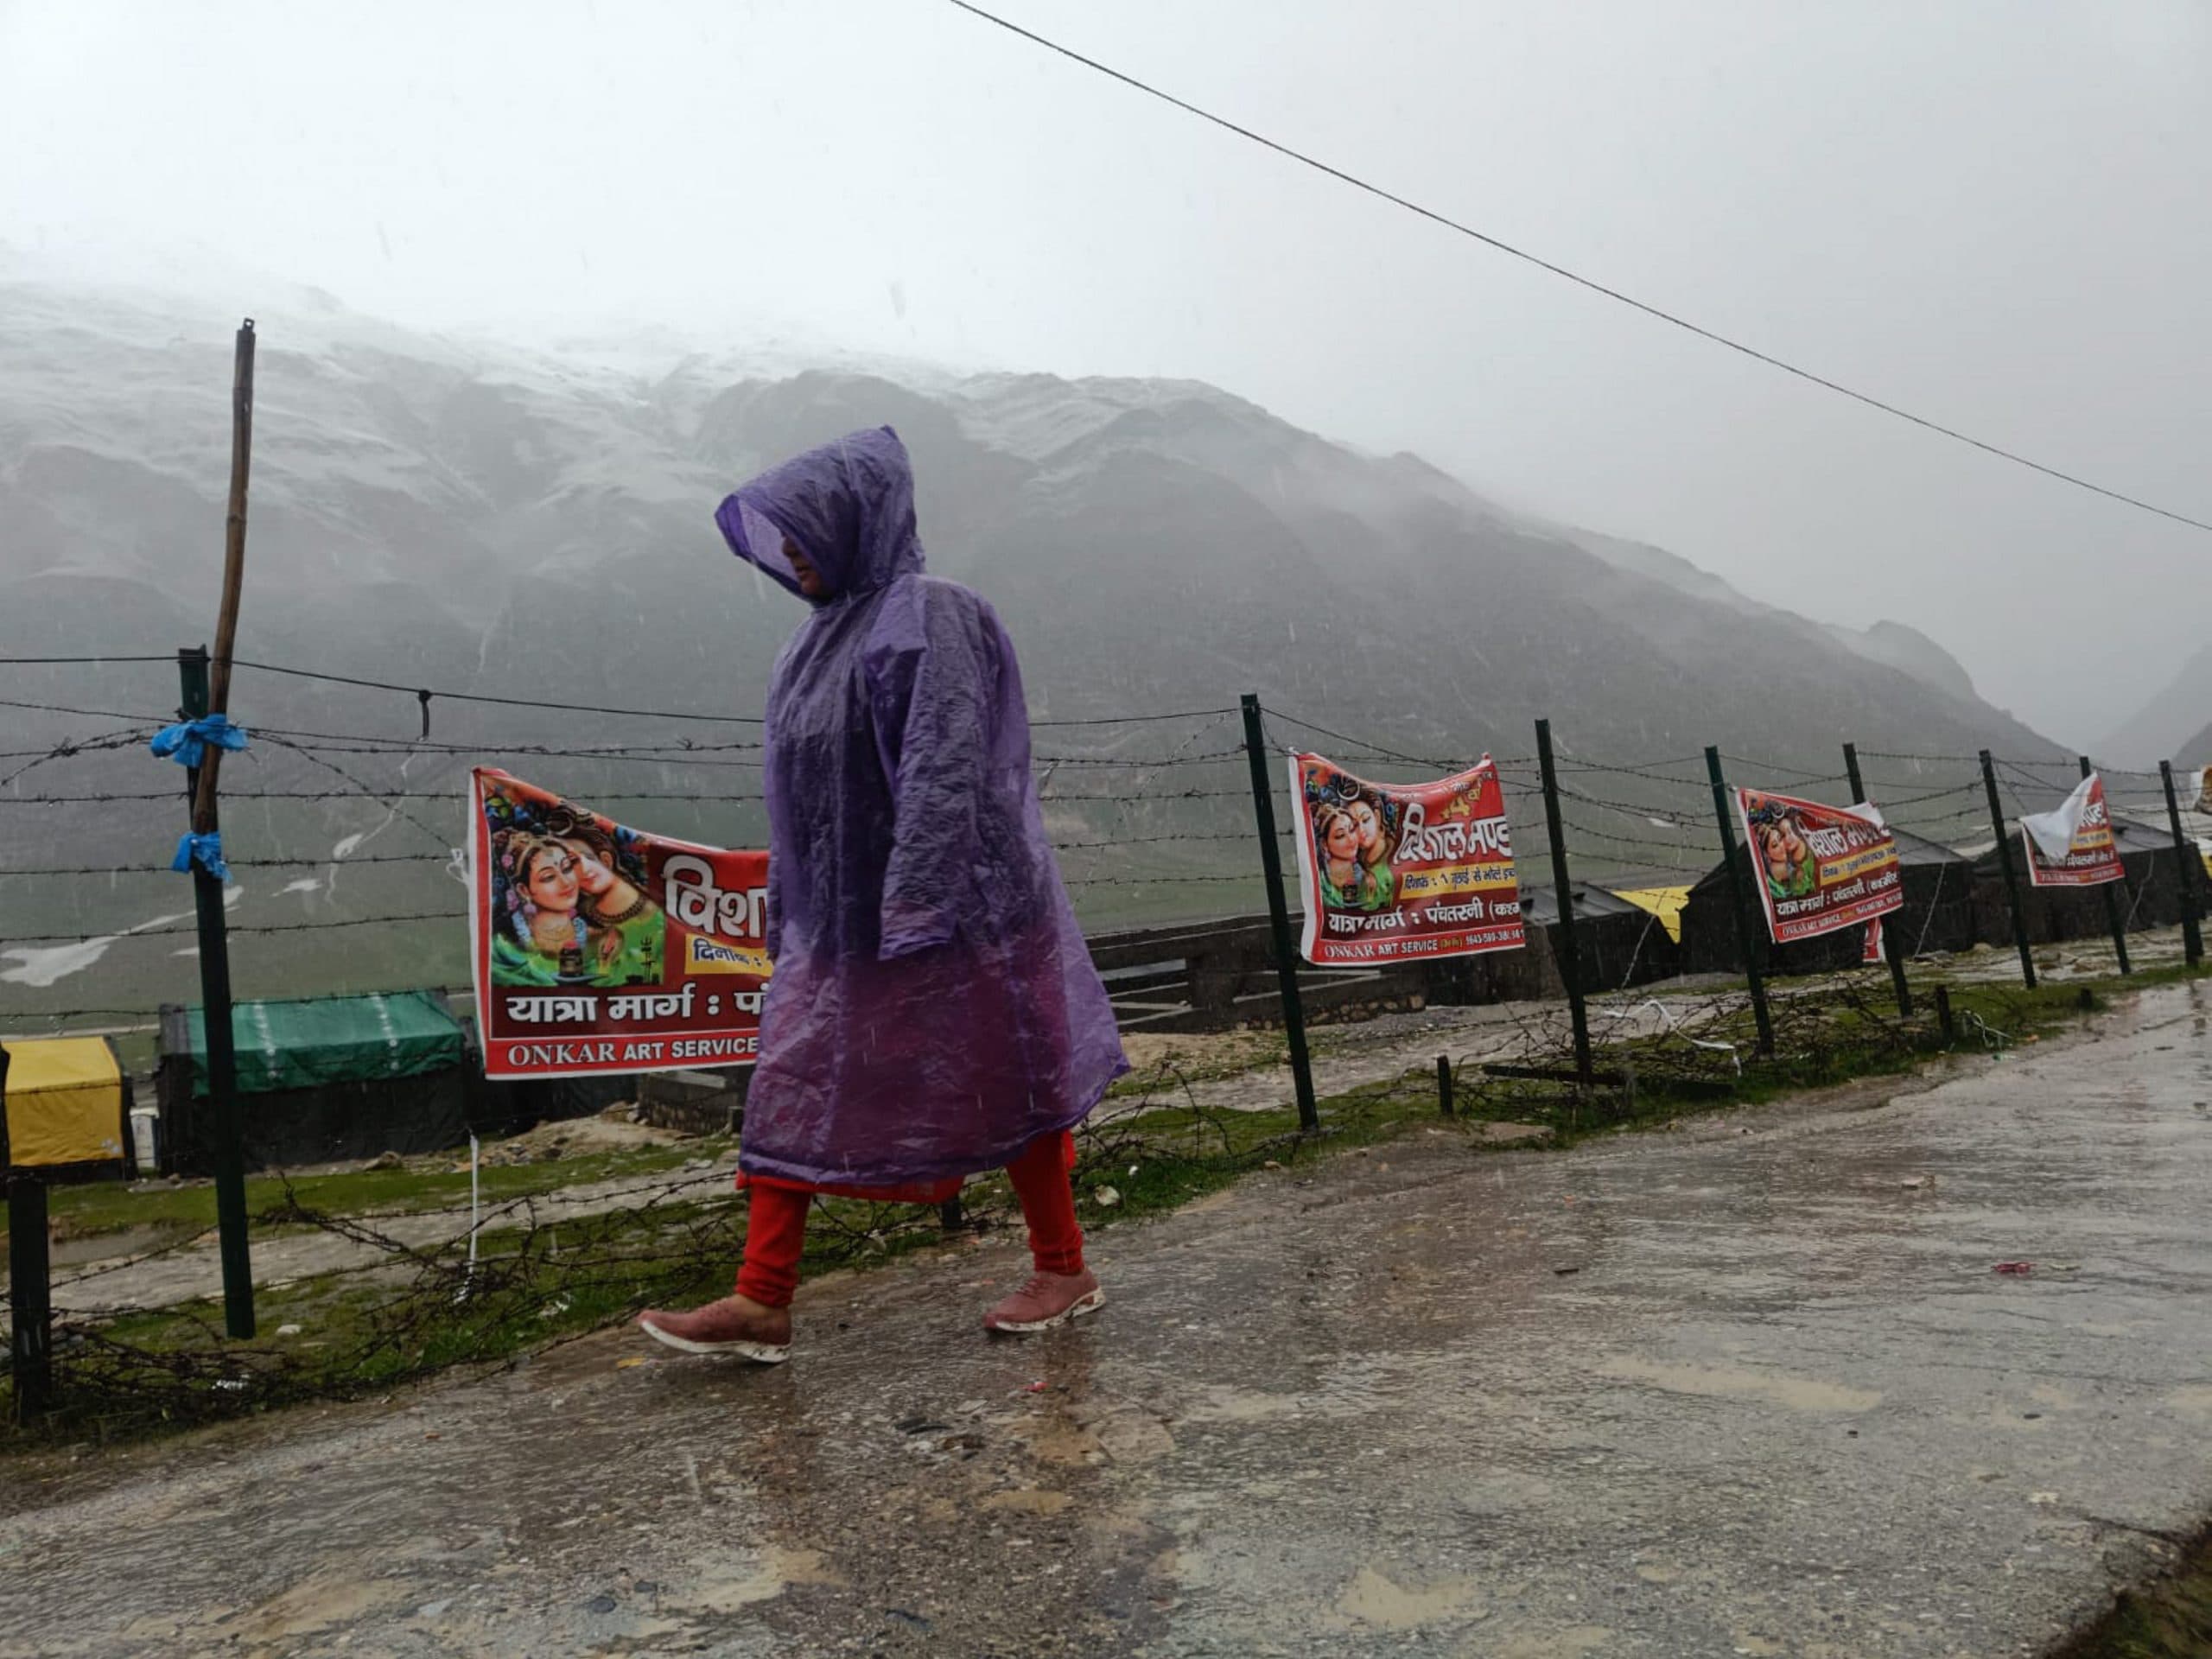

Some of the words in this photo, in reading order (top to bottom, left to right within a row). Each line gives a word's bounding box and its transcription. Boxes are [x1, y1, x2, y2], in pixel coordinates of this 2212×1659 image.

[1468, 816, 1513, 857] भण्ड
[663, 855, 767, 938] विश
[1377, 943, 1399, 956] ART
[1401, 938, 1438, 952] SERVICE
[505, 996, 598, 1023] यात्रा
[607, 982, 696, 1019] मार्ग
[507, 1042, 617, 1066] ONKAR
[622, 1041, 664, 1061] ART
[671, 1036, 760, 1058] SERVICE
